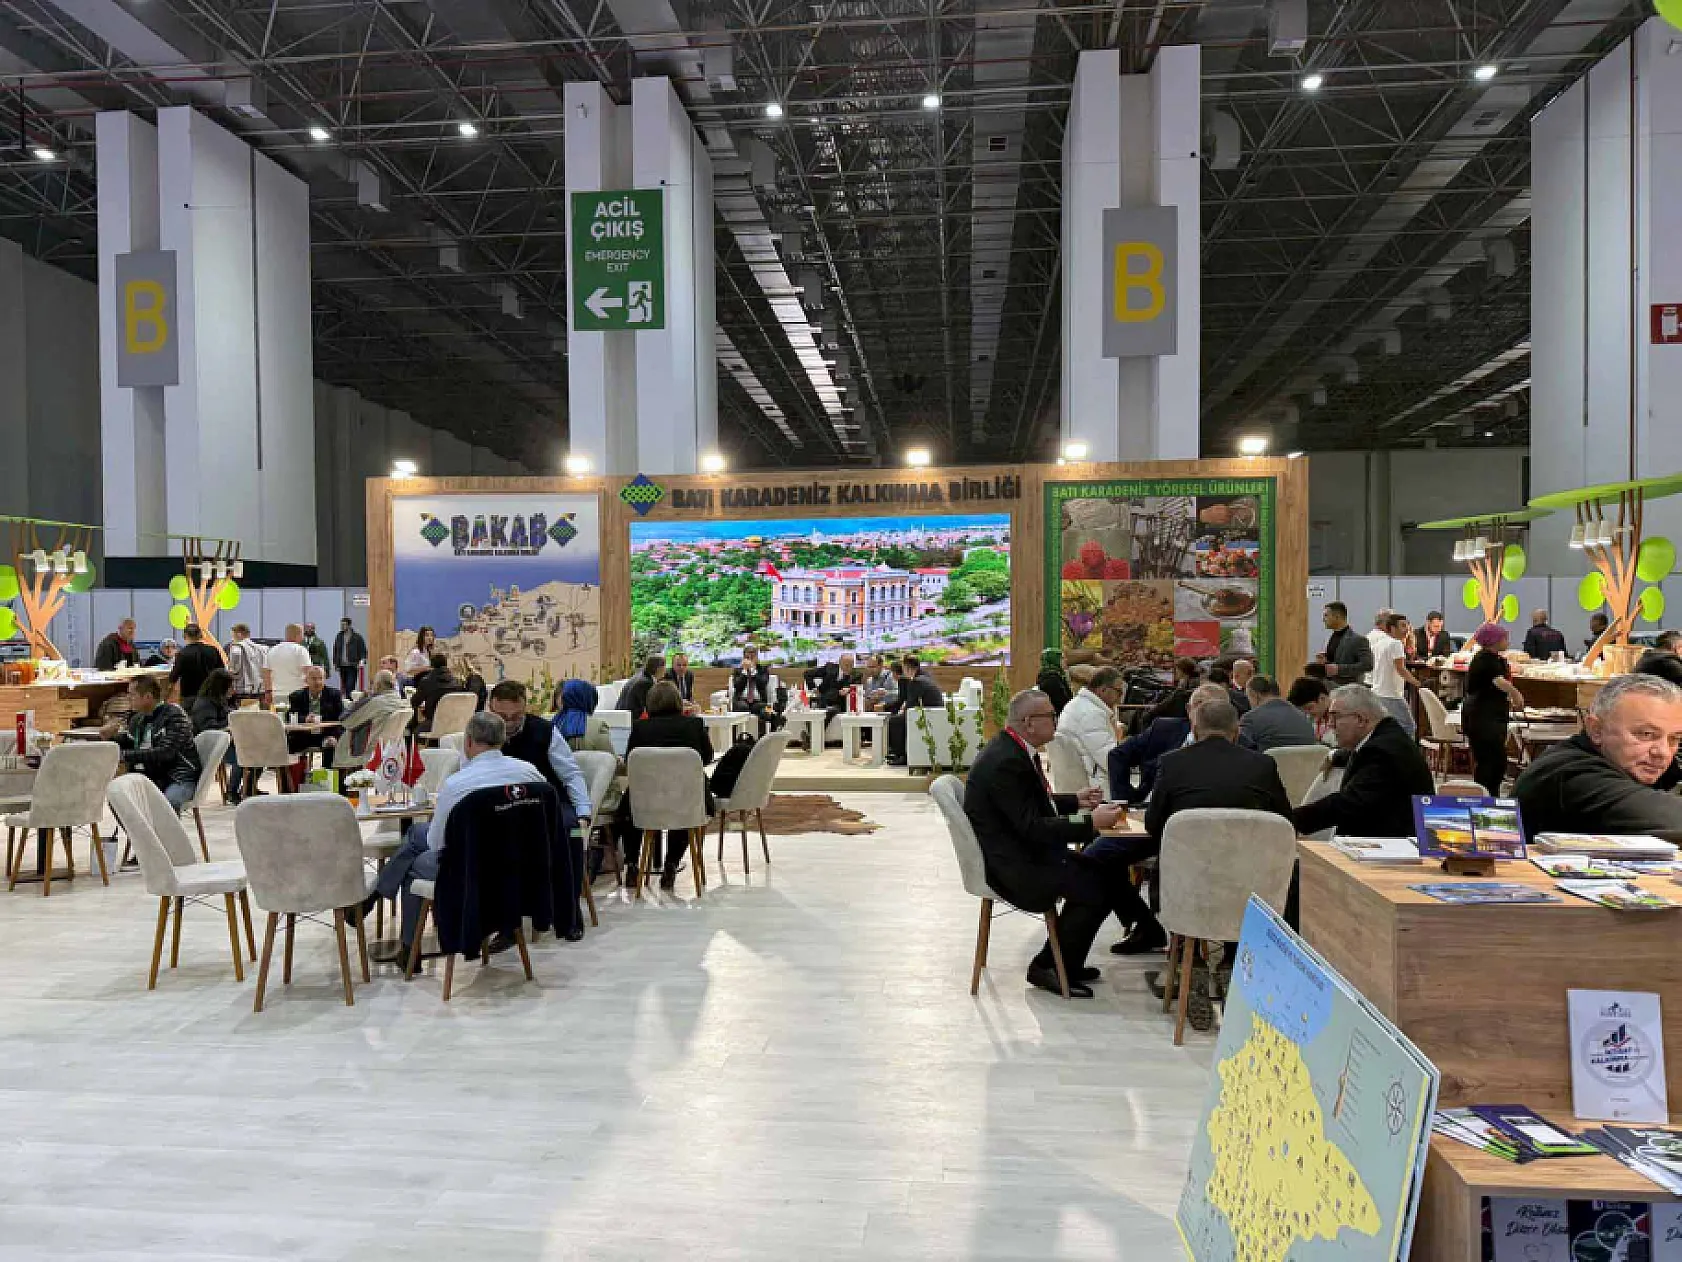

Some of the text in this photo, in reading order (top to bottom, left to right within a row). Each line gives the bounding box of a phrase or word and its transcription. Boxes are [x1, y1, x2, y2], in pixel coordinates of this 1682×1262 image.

[595, 196, 641, 218] ACİL
[590, 220, 645, 241] ÇIKIŞ
[584, 249, 651, 261] EMERGENCY
[606, 262, 630, 273] EXIT
[1114, 241, 1166, 322] B
[125, 279, 168, 354] B
[720, 481, 831, 507] KARADENİZ
[836, 483, 943, 505] KALKINMA
[948, 474, 1021, 502] BİRLİĞİ
[1051, 477, 1269, 498] BATI KARADENİZ YÖRESEL ÜRÜNLERİ
